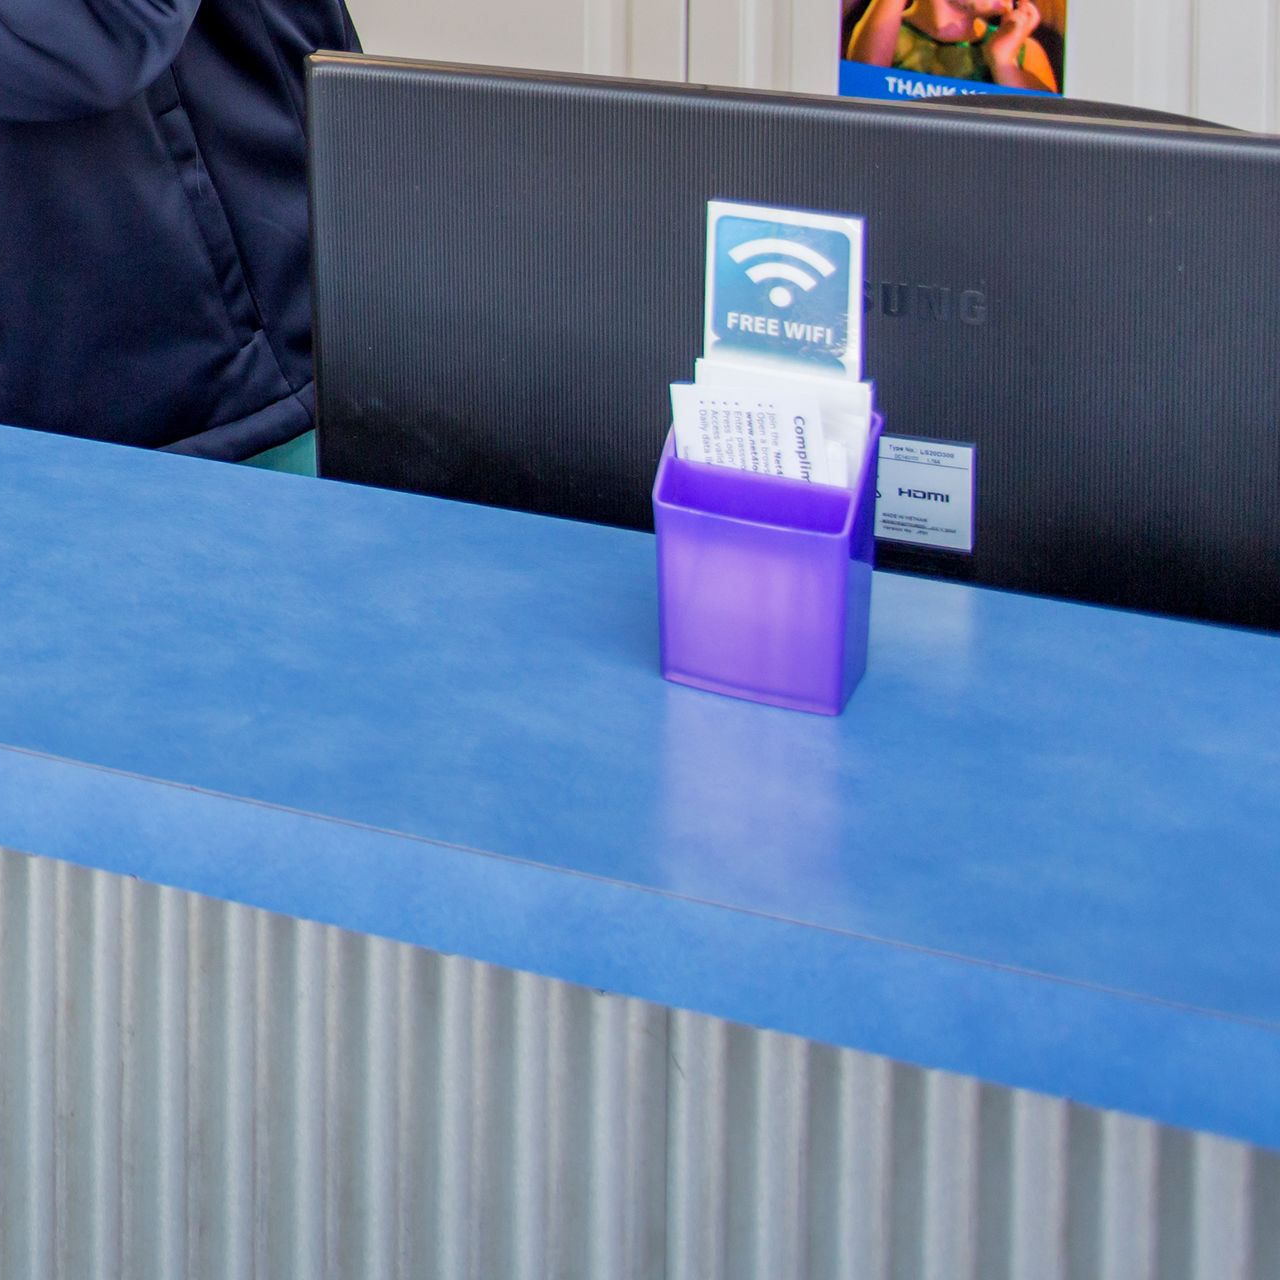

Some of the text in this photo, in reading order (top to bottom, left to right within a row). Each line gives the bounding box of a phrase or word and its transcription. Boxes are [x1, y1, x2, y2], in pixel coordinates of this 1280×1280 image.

[726, 311, 835, 346] FREE WIFI
[697, 409, 708, 432] Daily
[711, 410, 721, 440] Access
[722, 409, 732, 434] Press
[734, 410, 744, 434] Enter
[754, 411, 765, 436] Open
[766, 412, 778, 429] Join
[702, 434, 711, 454] data
[770, 431, 780, 447] the
[898, 487, 949, 503] HDMI
